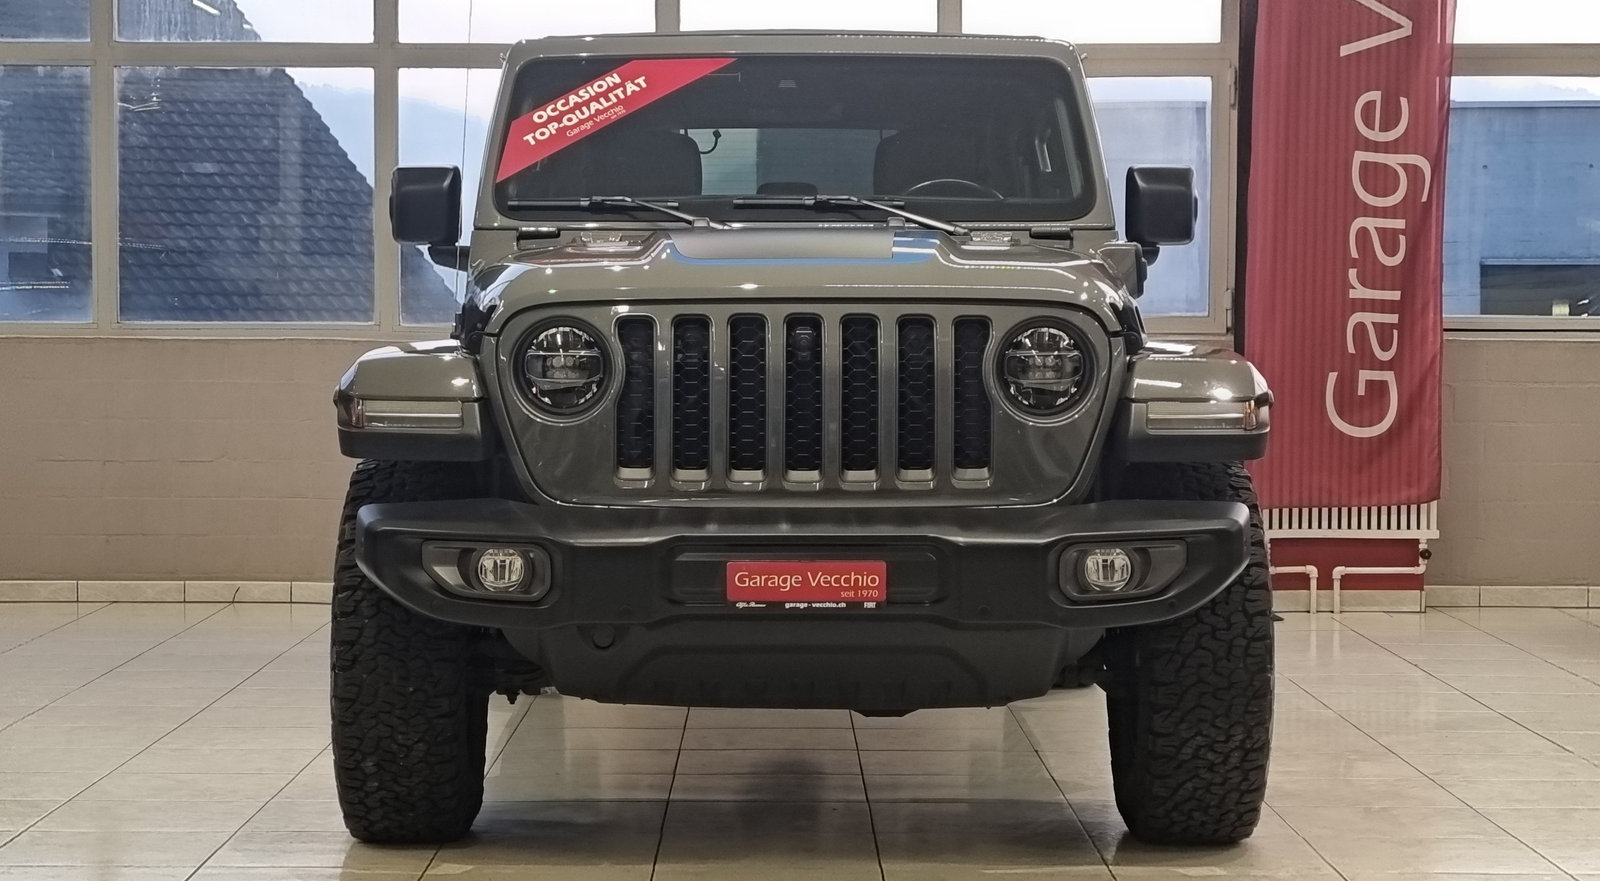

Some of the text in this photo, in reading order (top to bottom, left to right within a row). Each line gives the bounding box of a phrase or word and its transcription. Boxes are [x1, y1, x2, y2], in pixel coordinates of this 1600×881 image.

[523, 76, 648, 145] TOP-QUALITÄT
[532, 73, 622, 123] OCCASION
[566, 120, 594, 137] Garage
[593, 105, 624, 122] Vecchio
[1326, 90, 1432, 438] Garage
[734, 571, 880, 592] Garage Vecchio
[840, 589, 879, 598] seit 1970
